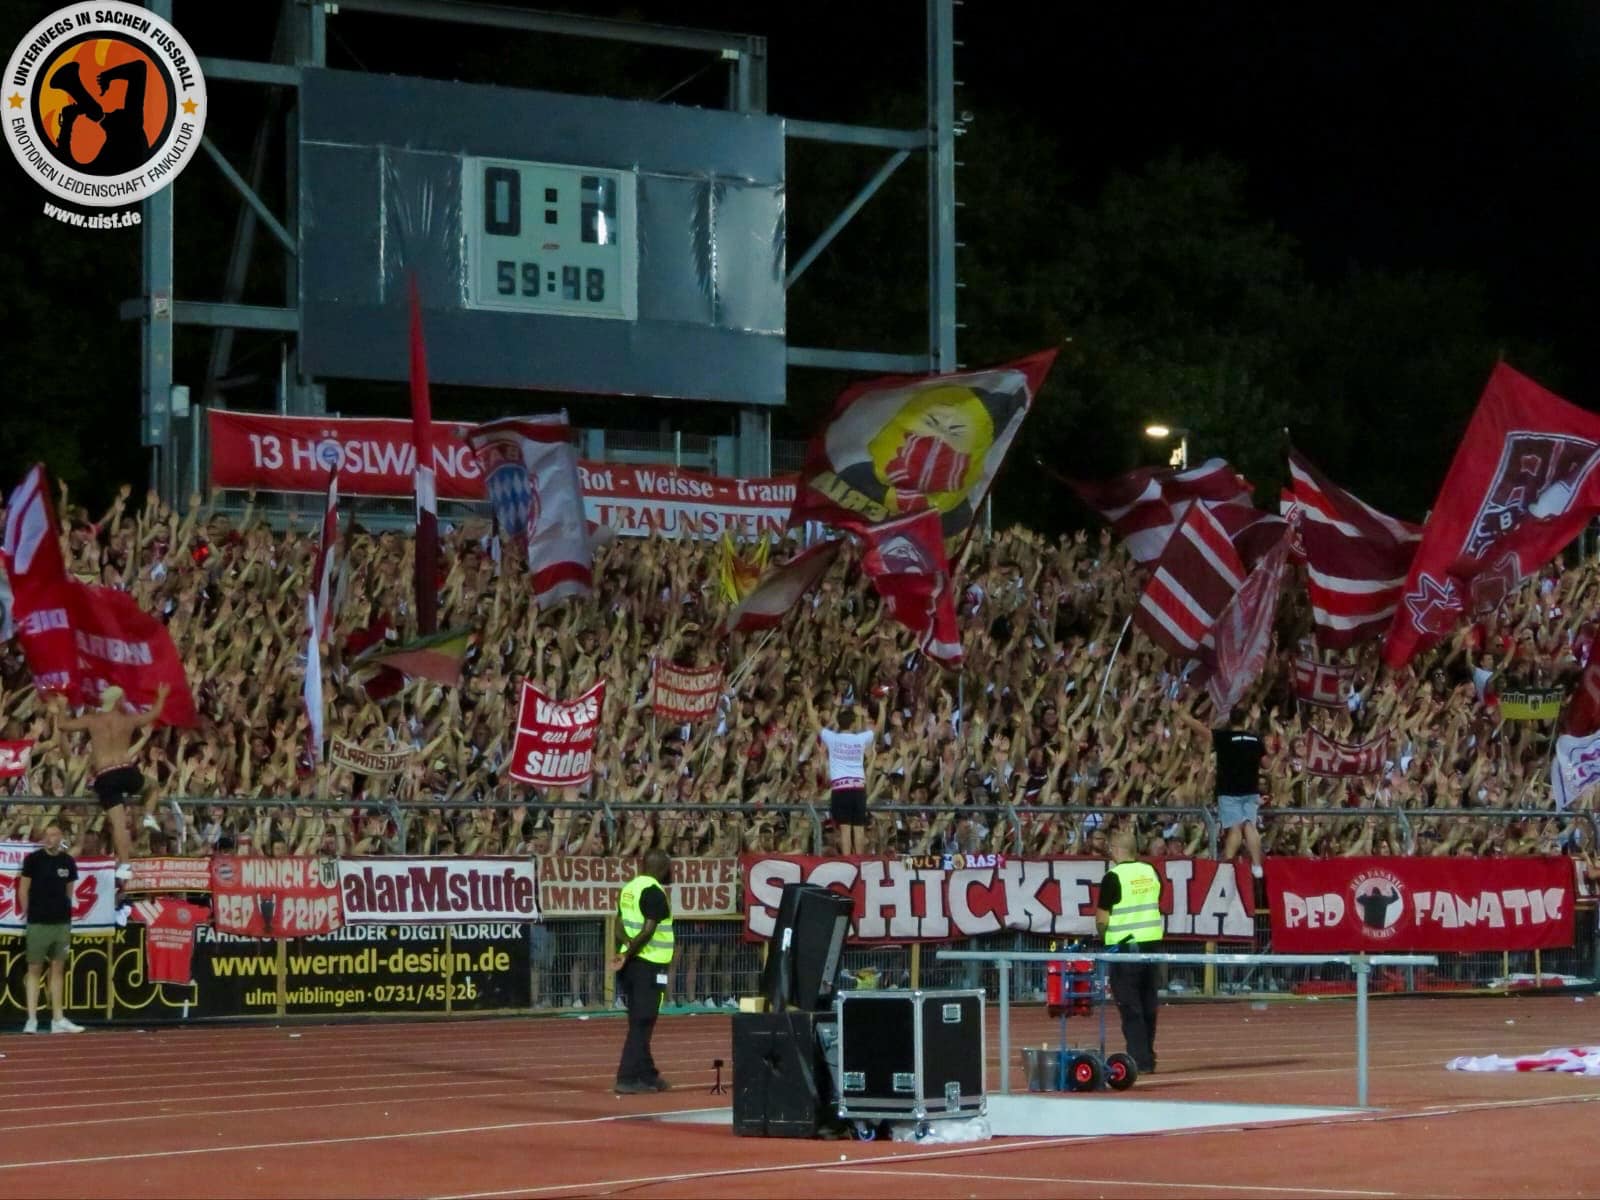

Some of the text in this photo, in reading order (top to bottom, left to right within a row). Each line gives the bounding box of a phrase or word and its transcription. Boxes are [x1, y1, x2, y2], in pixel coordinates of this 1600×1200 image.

[497, 260, 605, 302] 59:48
[251, 434, 284, 470] 13
[577, 466, 615, 490] Rot
[635, 469, 714, 497] Weisse
[736, 478, 796, 502] Traun
[595, 504, 788, 539] TRAUNSTEIN
[540, 856, 737, 884] AUSGESRRTE
[343, 866, 535, 913] alarMstufe
[680, 885, 731, 911] UNS
[749, 859, 1254, 938] SHICKEIA
[218, 895, 340, 930] RED PRIDE
[1283, 888, 1565, 929] RED FANATIC
[399, 924, 522, 940] DIGITALDRUCK
[211, 946, 510, 977] www.werndl-design.de
